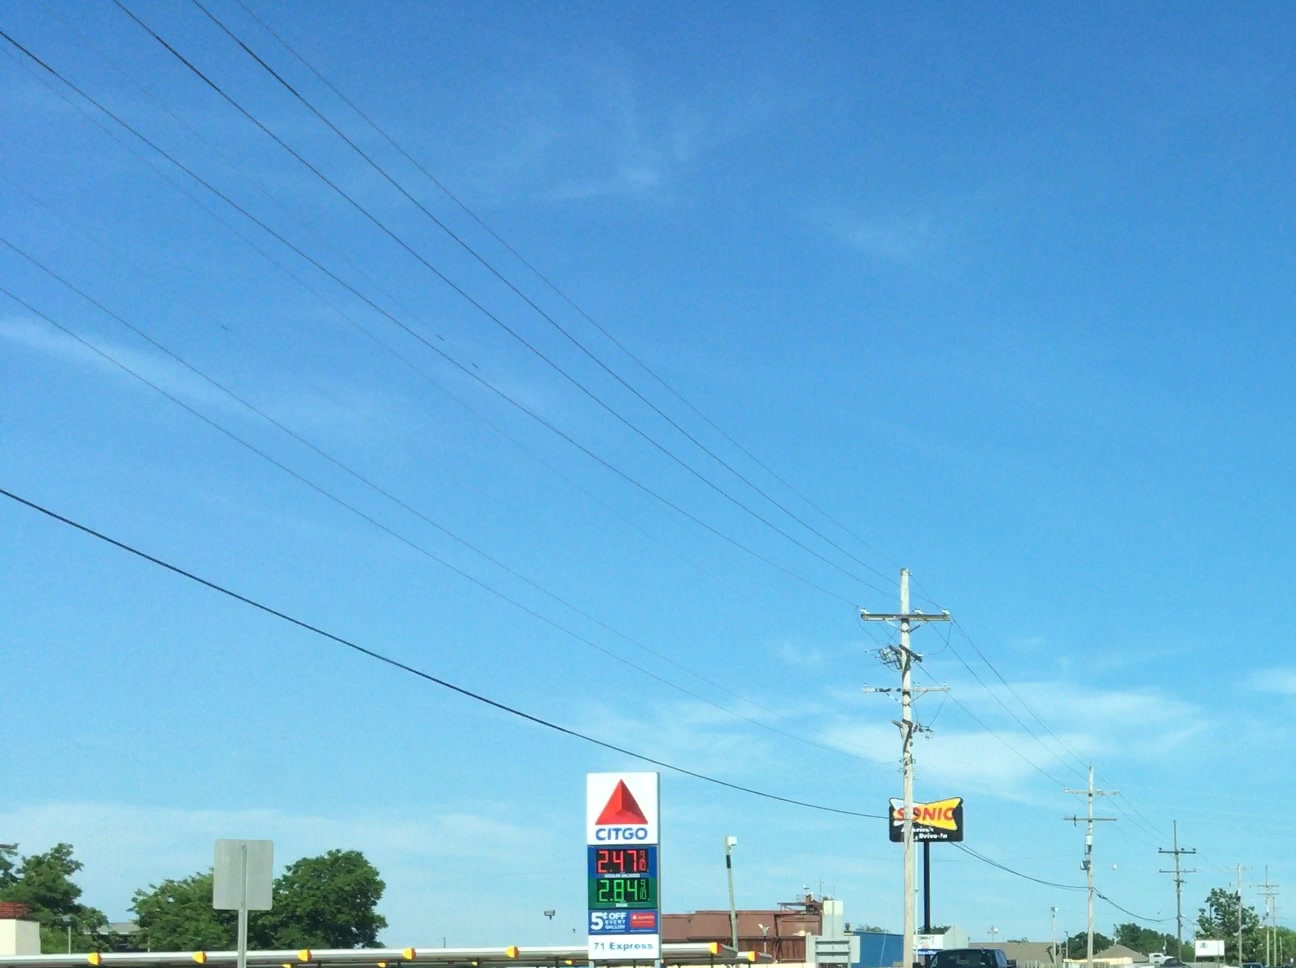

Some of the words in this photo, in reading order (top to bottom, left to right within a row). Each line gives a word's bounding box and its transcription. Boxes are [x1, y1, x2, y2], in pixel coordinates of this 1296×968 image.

[897, 807, 954, 821] SONIC
[596, 828, 648, 841] CITGO
[594, 942, 605, 950] 71
[609, 942, 653, 951] Express
